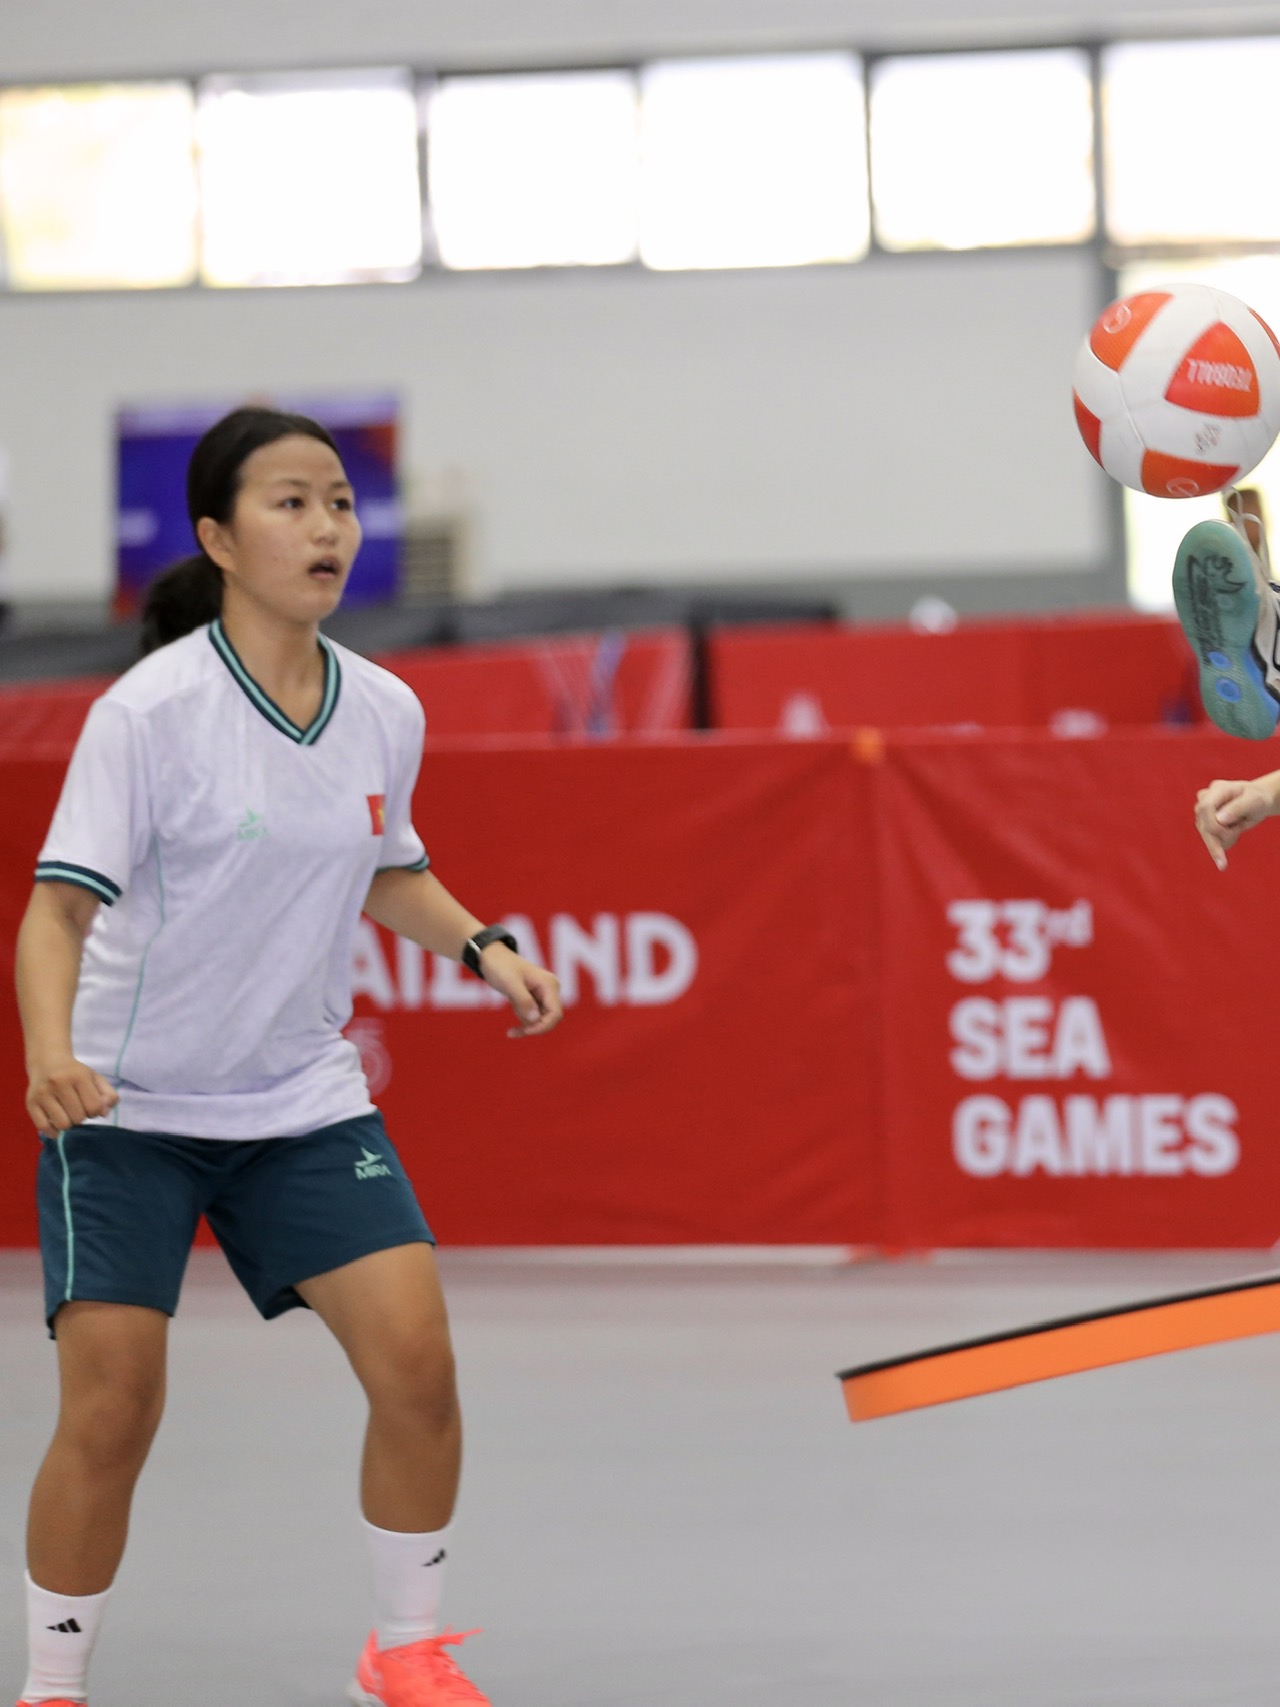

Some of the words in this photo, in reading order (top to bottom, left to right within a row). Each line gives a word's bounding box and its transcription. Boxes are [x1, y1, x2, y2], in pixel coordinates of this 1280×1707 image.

[352, 910, 699, 1013] AILAND
[950, 995, 1113, 1082] SEA
[953, 1092, 1241, 1179] GAMES
